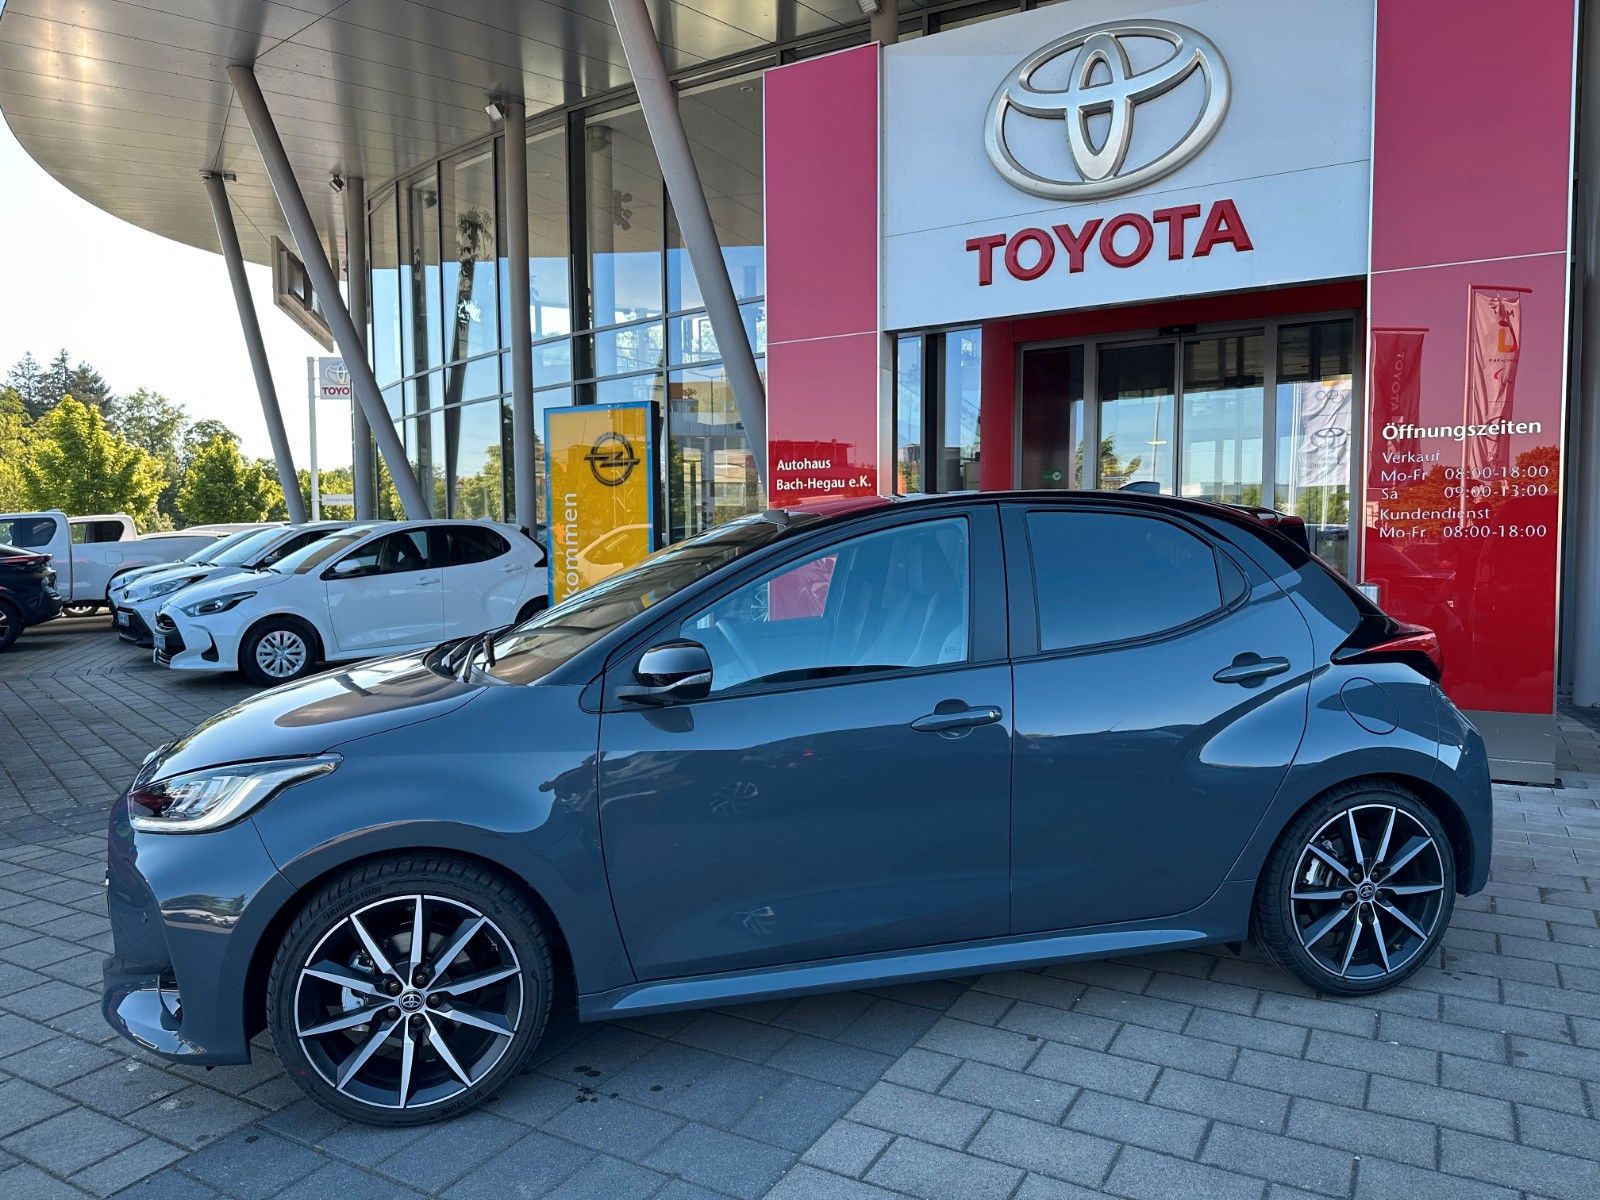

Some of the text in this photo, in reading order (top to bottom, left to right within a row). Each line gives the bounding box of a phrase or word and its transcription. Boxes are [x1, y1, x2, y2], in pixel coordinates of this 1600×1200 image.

[966, 198, 1254, 287] TOYOTA
[321, 386, 352, 395] TOYO
[1382, 421, 1542, 441] Öffnungszeiten
[776, 458, 831, 471] Autohaus
[1382, 450, 1441, 464] Verkauf
[1381, 465, 1549, 482] Mo-Fr 08:00-18:00
[776, 474, 872, 492] Bach-Hegau e.K.
[1381, 484, 1549, 500] Sa 09:00-13:00
[1380, 507, 1490, 520] Kundendienst
[1379, 523, 1547, 539] Mo-Fr 08:00-18:00
